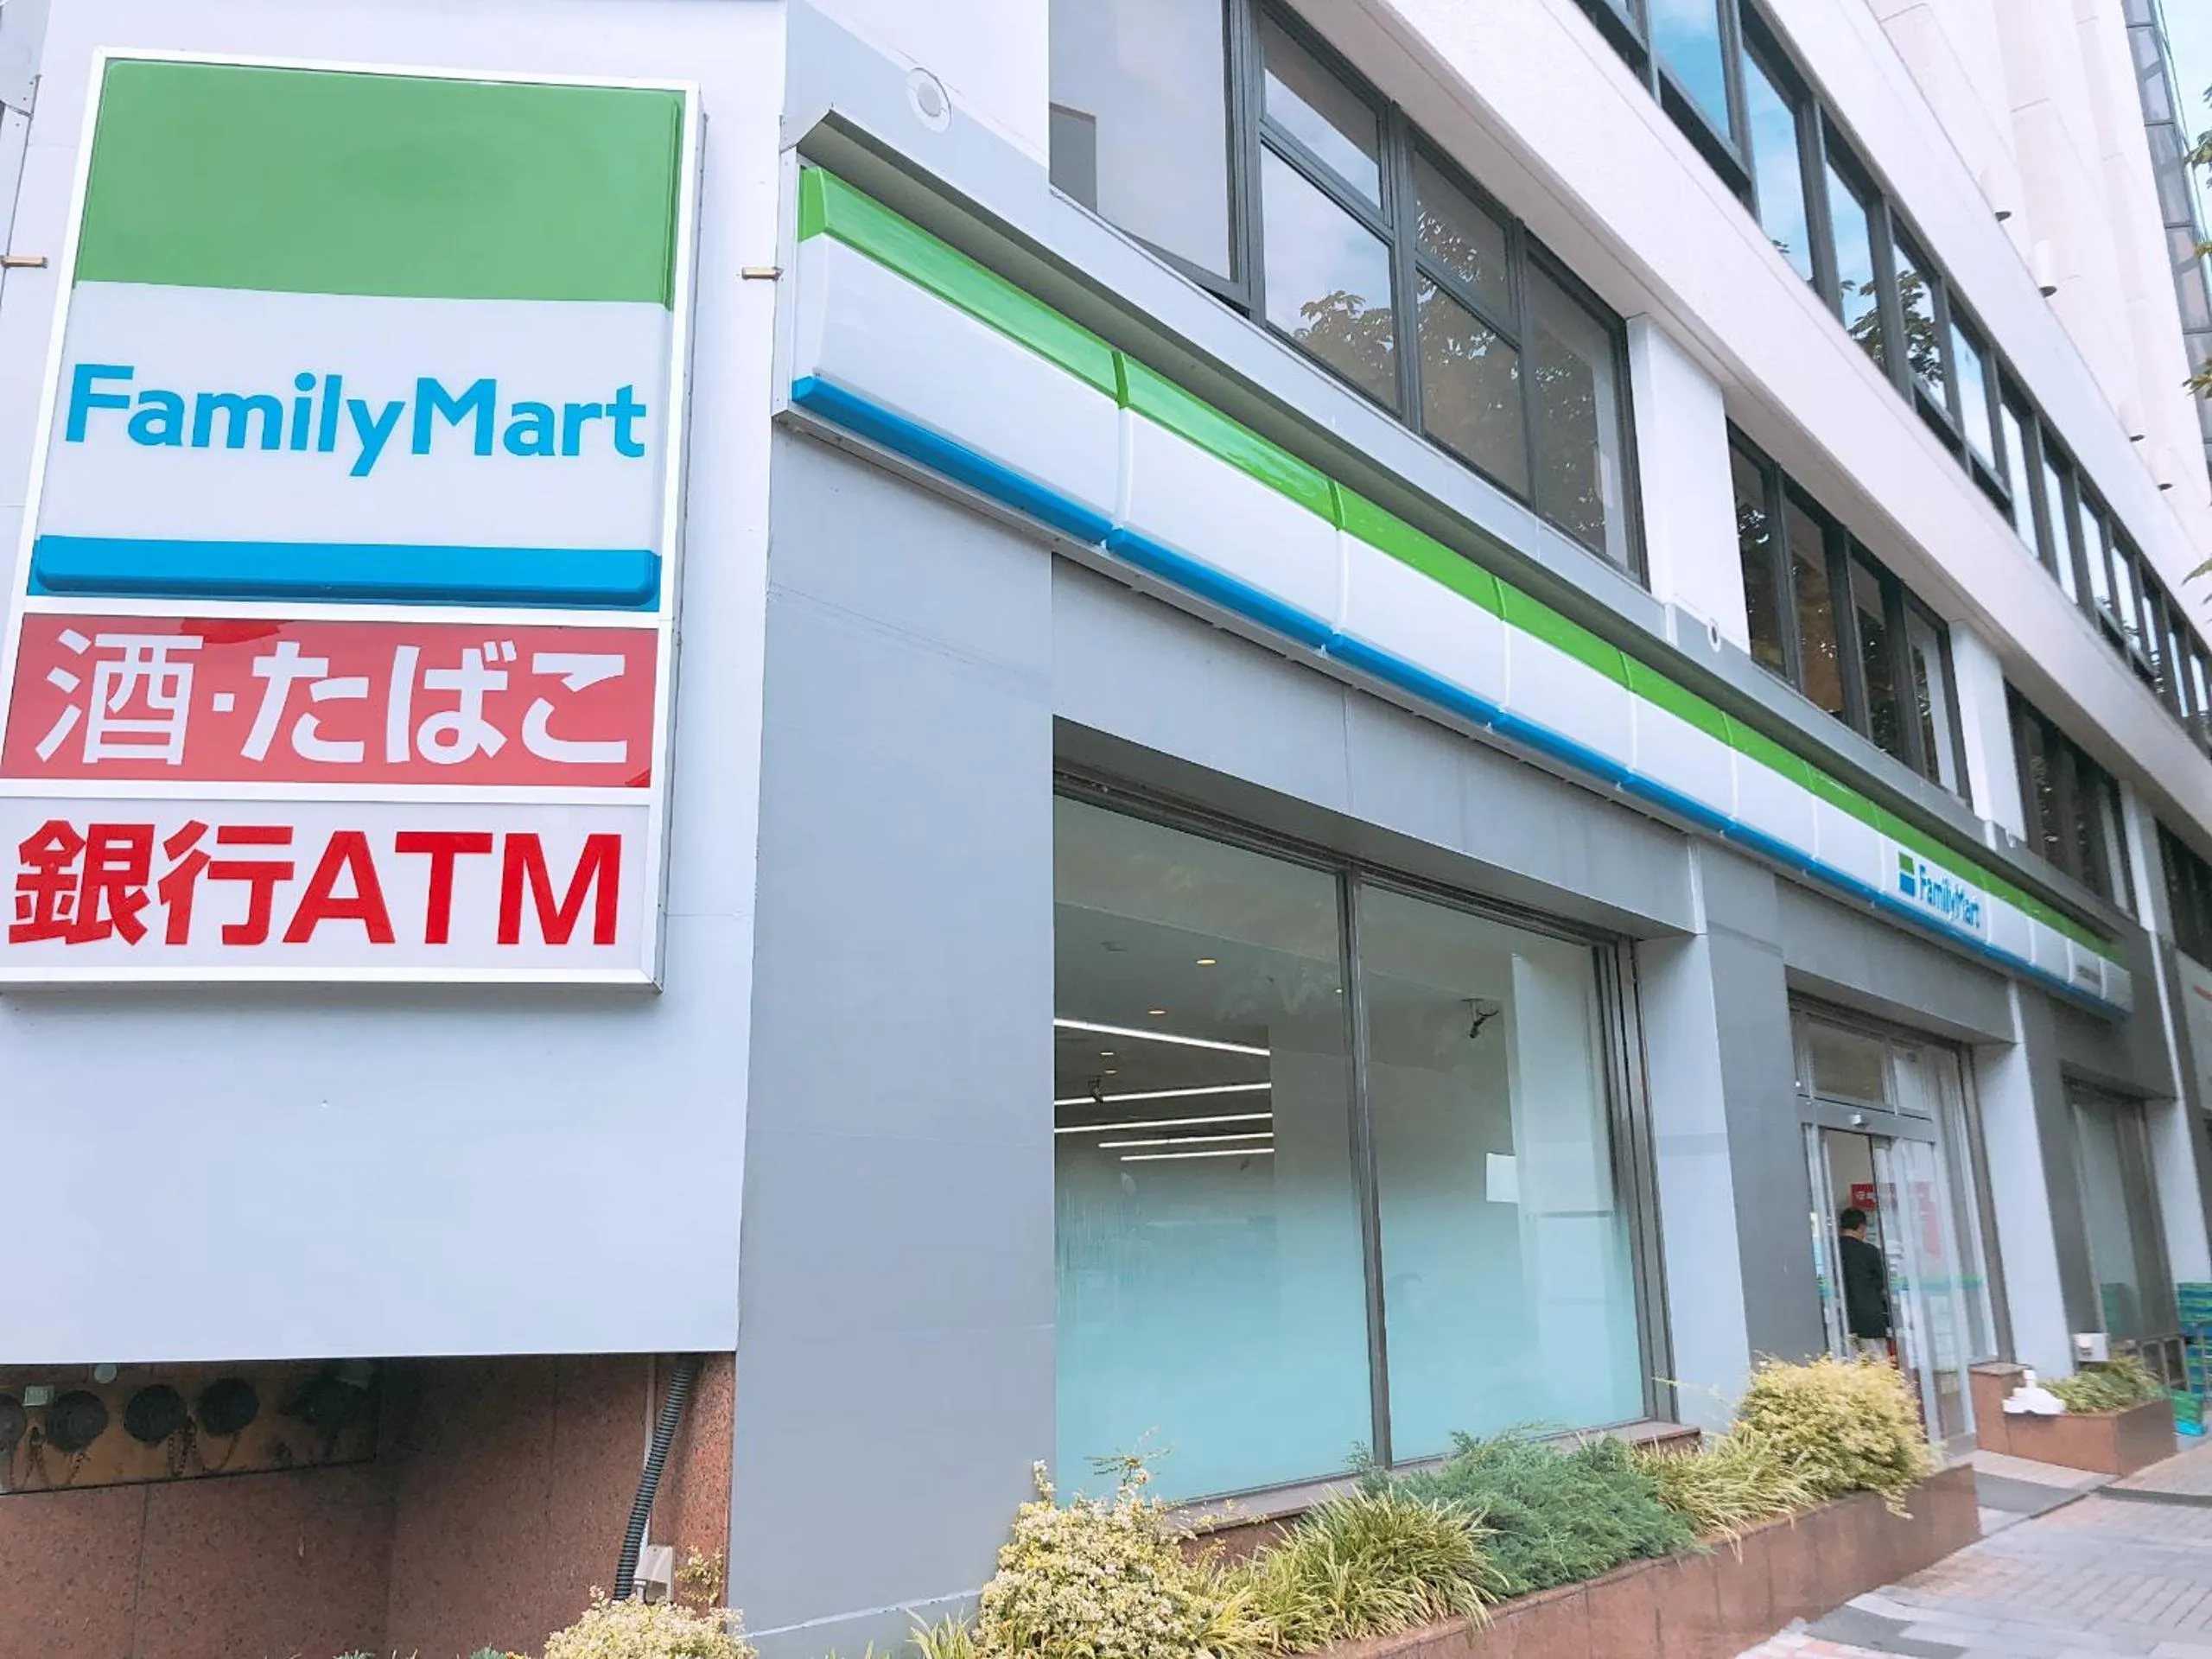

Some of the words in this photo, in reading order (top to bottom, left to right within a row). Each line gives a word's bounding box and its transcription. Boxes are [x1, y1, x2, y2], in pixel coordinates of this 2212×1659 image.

[65, 363, 647, 477] FamilyMart
[9, 818, 622, 946] 銀行ATM
[1918, 864, 1980, 928] FamilyMart
